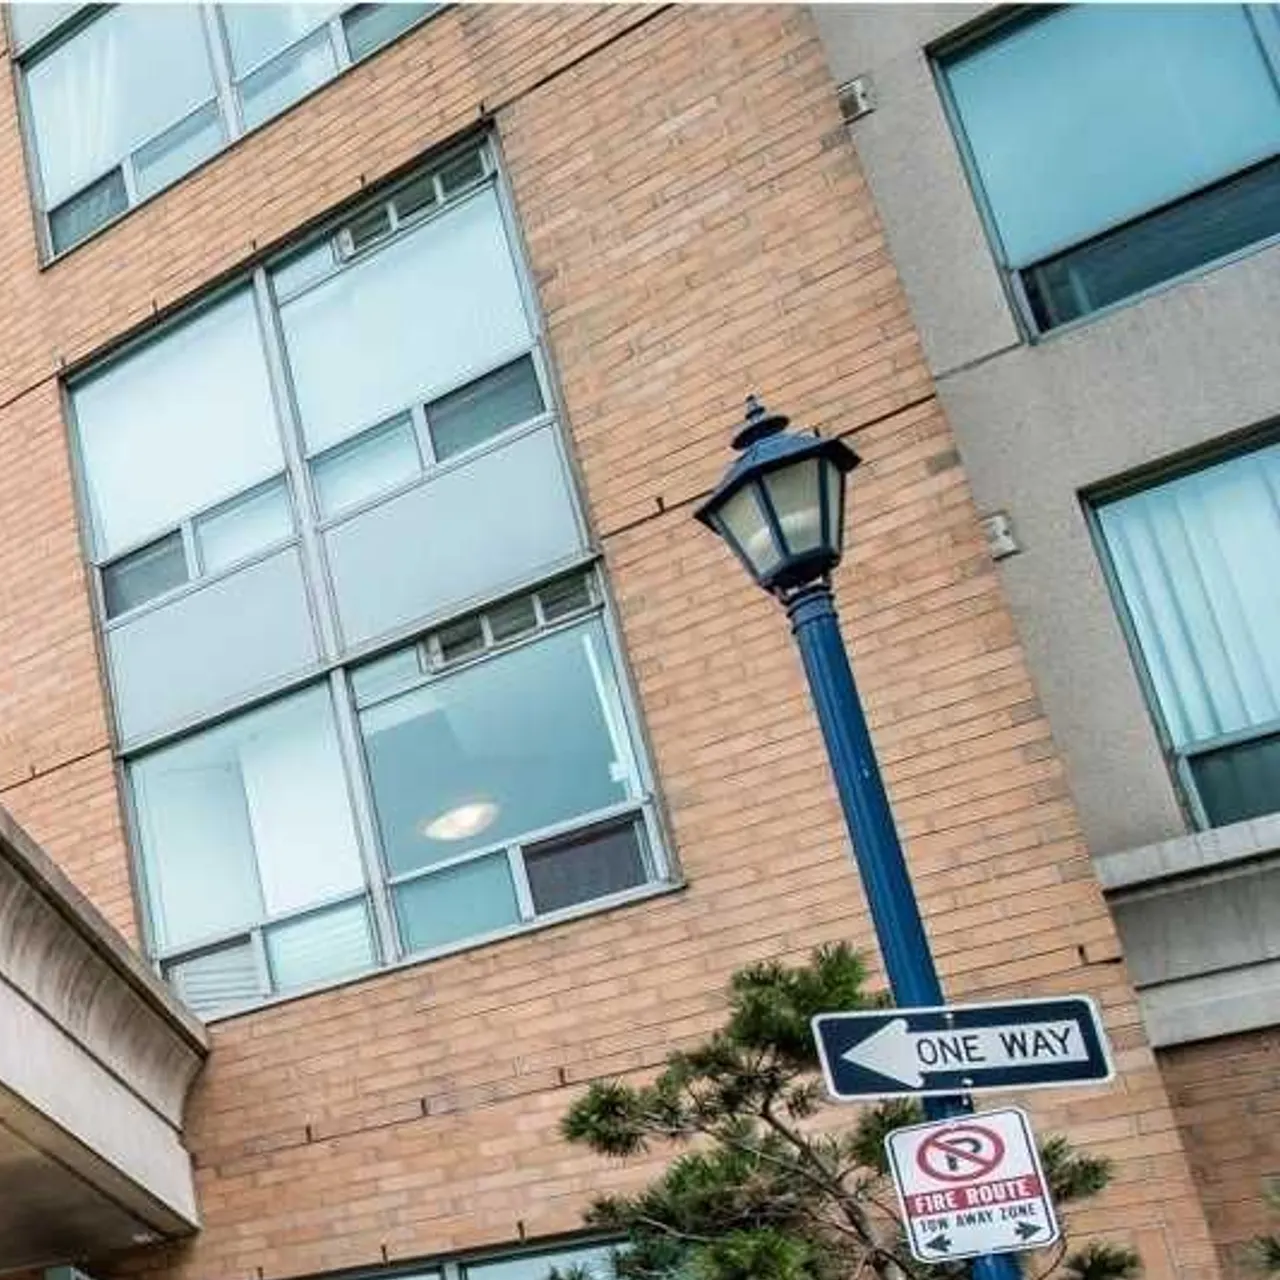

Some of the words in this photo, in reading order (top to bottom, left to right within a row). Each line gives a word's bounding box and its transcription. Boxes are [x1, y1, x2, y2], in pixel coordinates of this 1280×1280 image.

[915, 1034, 986, 1066] ONE
[998, 1026, 1071, 1060] WAY
[915, 1190, 958, 1214] FIRE
[965, 1178, 1032, 1206] ROUTE
[920, 1217, 949, 1233] TOW
[955, 1209, 994, 1227] AWAY
[999, 1202, 1037, 1220] ZONE
